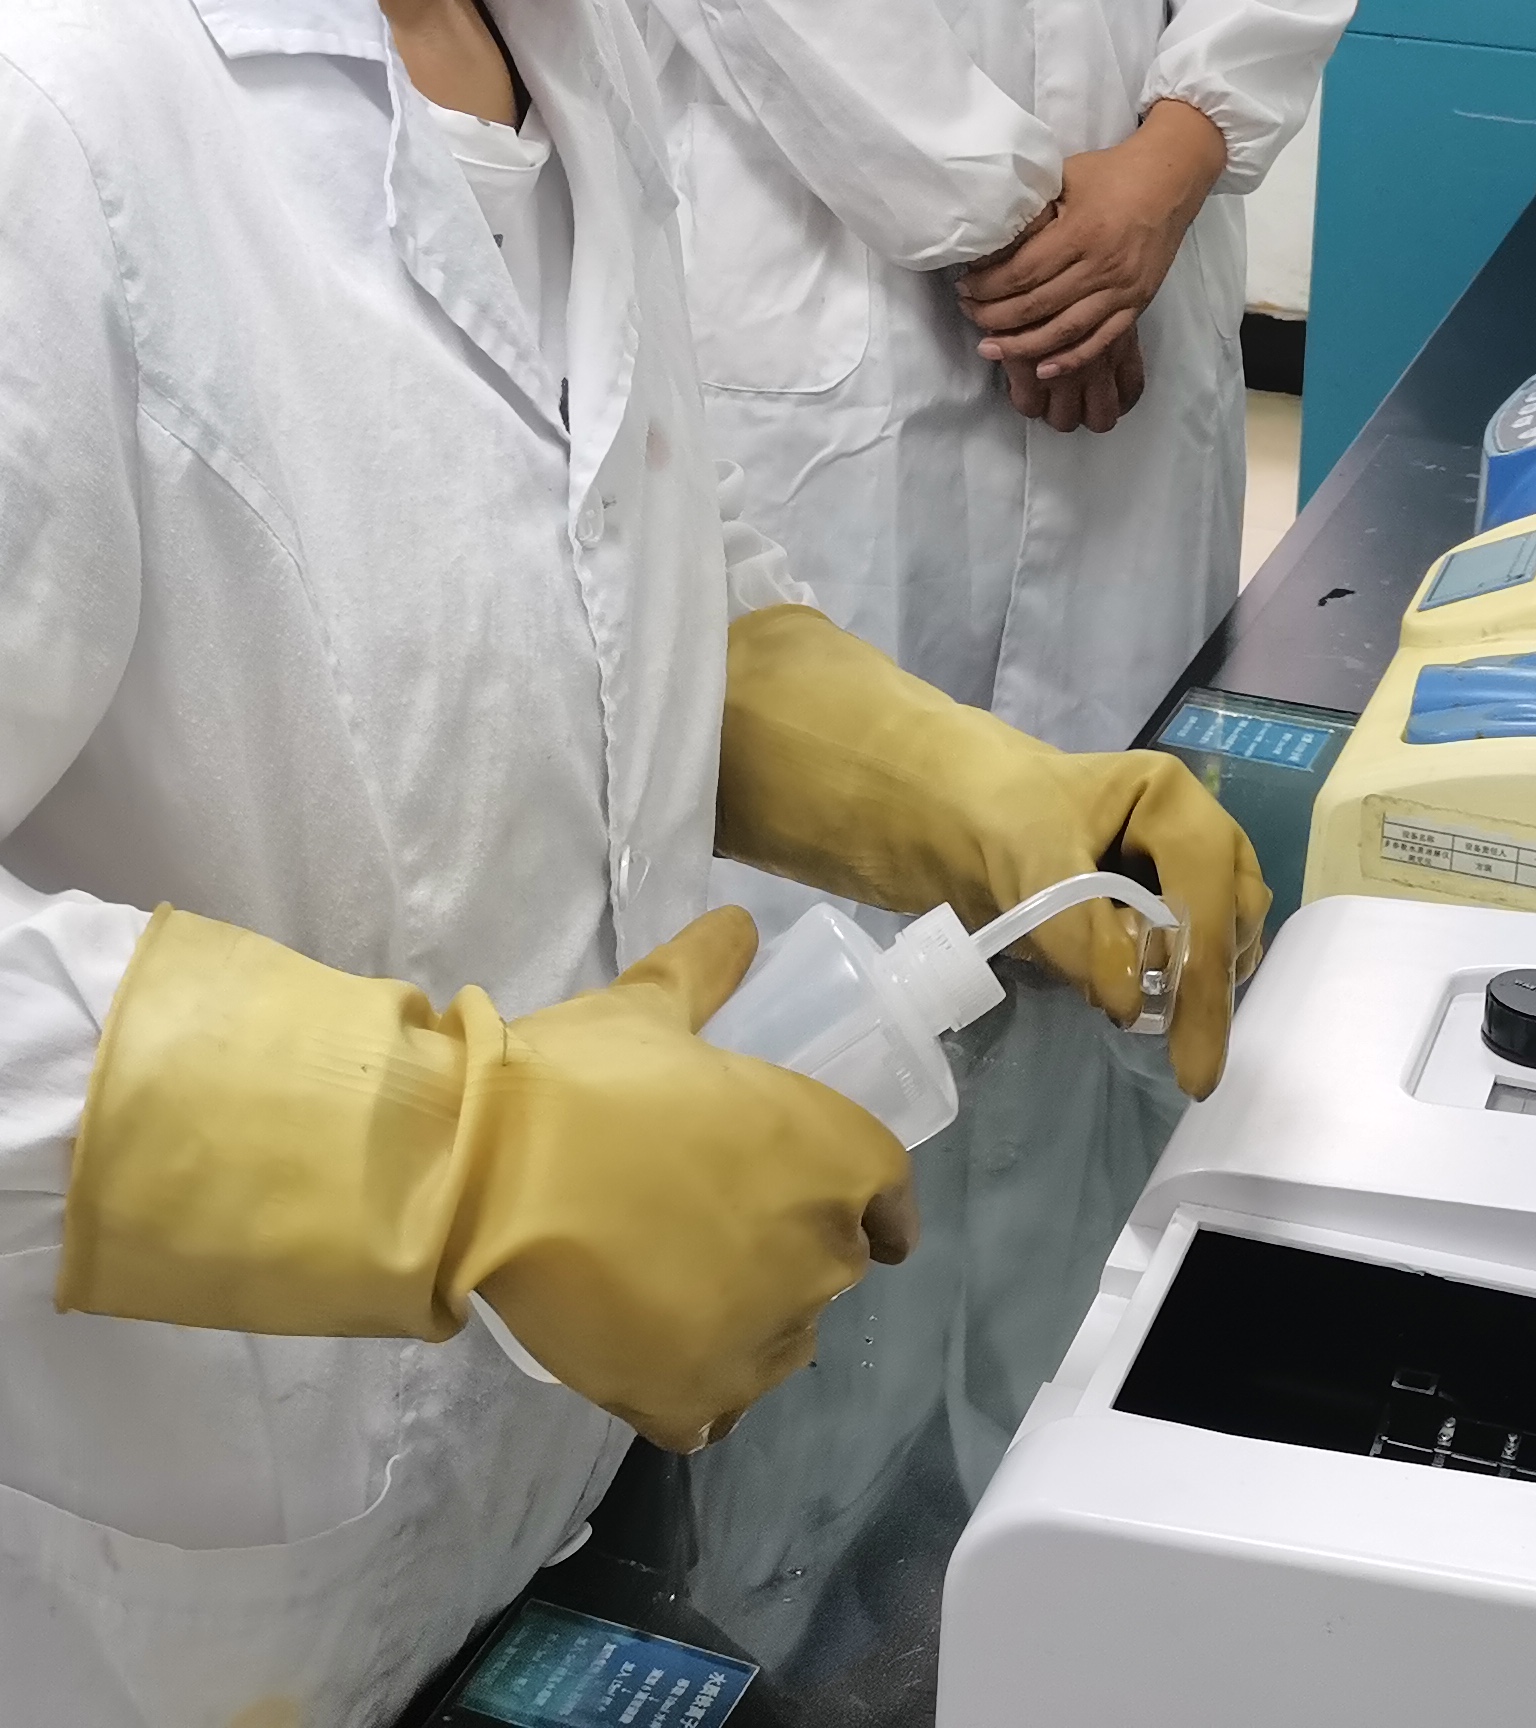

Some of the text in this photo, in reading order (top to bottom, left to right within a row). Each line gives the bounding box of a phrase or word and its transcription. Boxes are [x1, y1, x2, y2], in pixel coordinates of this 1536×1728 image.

[1465, 843, 1507, 858] 设备责任人
